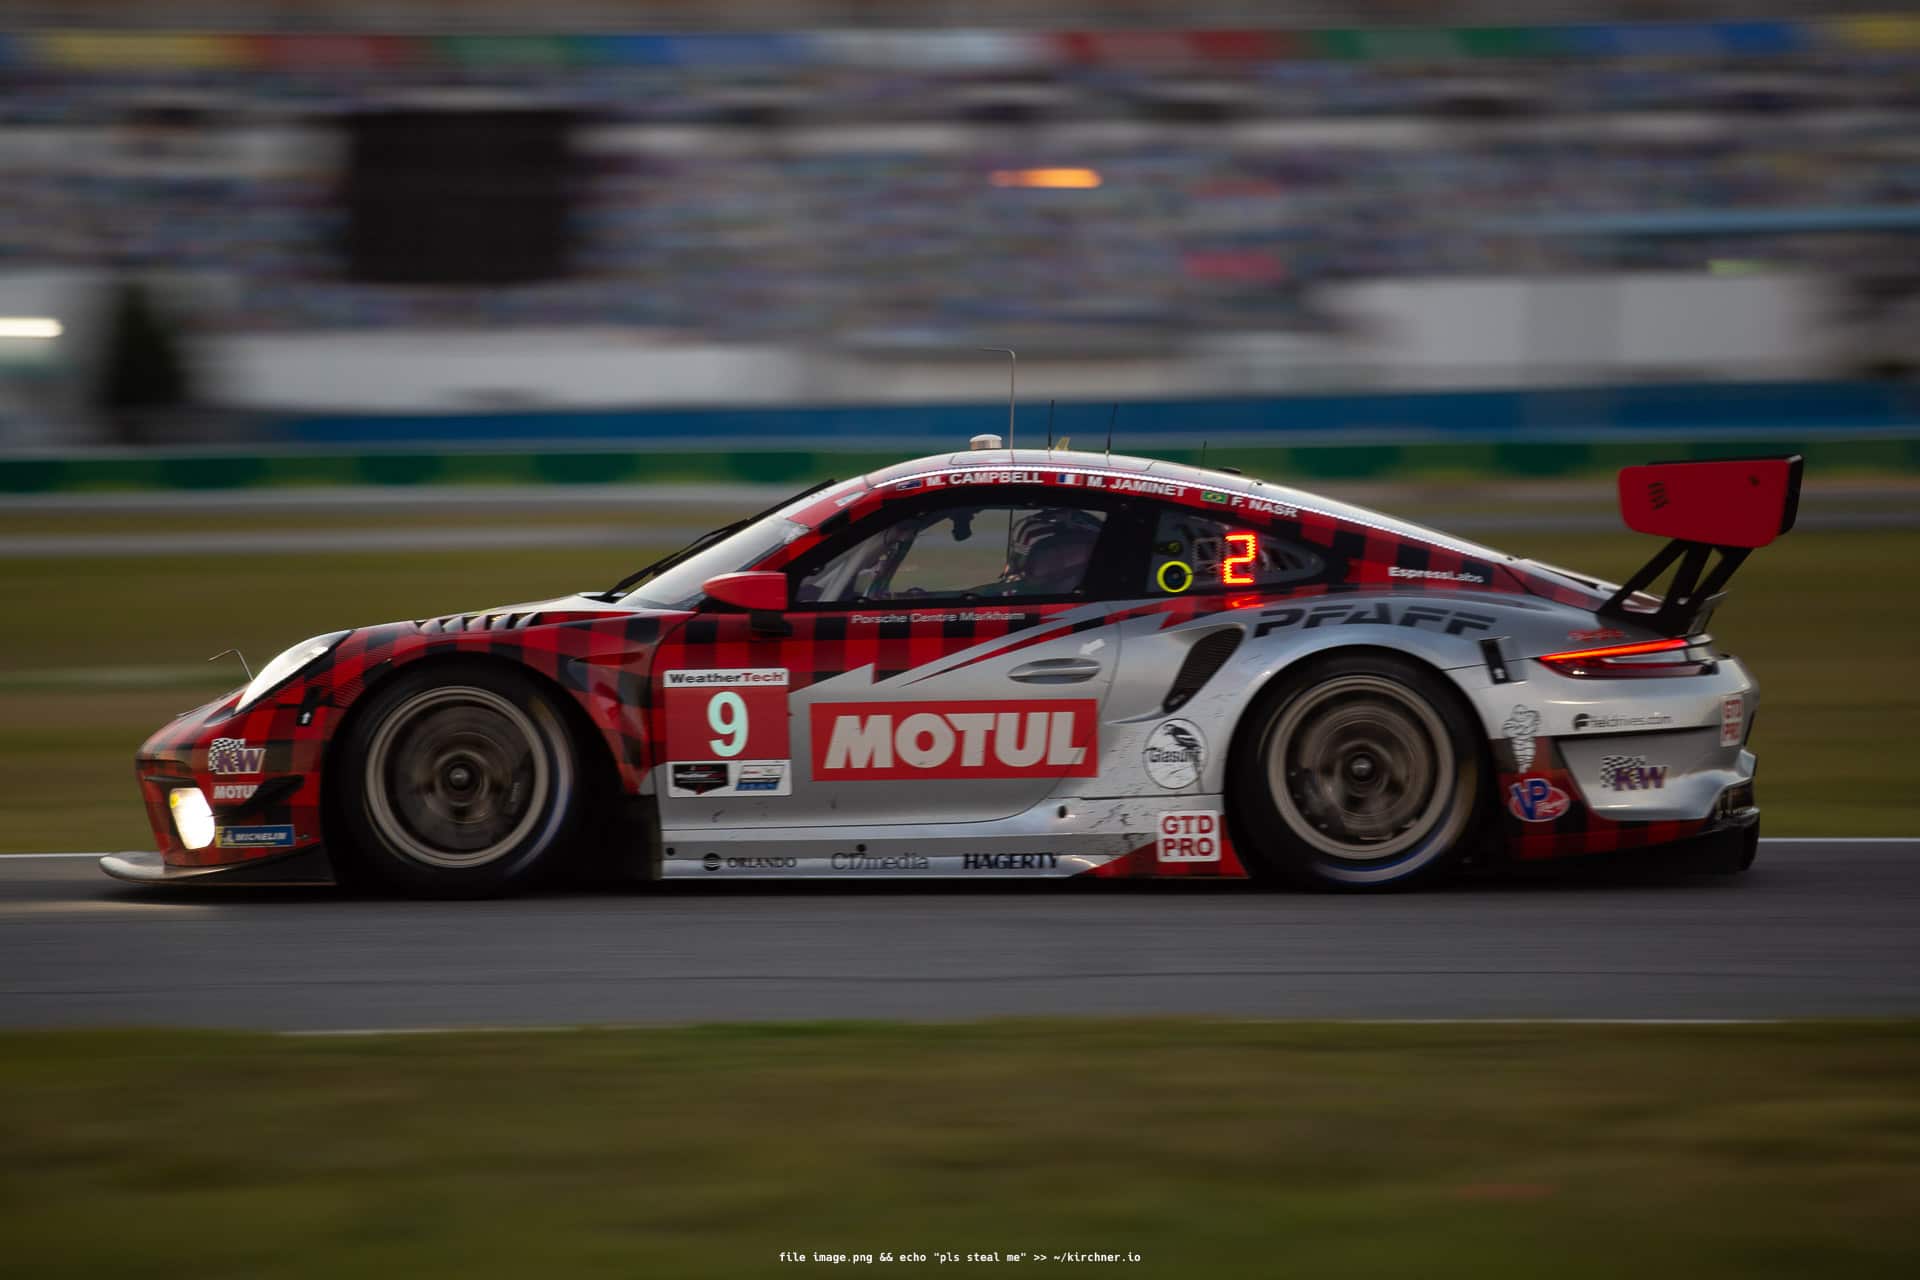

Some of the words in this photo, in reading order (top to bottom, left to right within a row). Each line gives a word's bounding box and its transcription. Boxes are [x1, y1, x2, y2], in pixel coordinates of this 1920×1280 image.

[926, 476, 946, 487] M.
[950, 471, 1044, 485] CAMPBELL
[1087, 475, 1106, 489] M.
[1109, 477, 1185, 497] JAMINET
[1231, 496, 1245, 507] F.
[1248, 499, 1298, 518] NASR
[1223, 533, 1256, 584] 2
[1388, 566, 1485, 583] EspressLabs
[851, 614, 907, 624] Porsche
[910, 612, 957, 622] Centre
[1253, 603, 1497, 638] PFAFF
[669, 672, 783, 683] WeatherTech
[707, 691, 749, 757] 9
[824, 711, 1088, 769] MOTUL
[217, 748, 265, 773] KW
[1614, 766, 1668, 791] KW
[1162, 815, 1214, 835] GTD
[1163, 838, 1214, 857] PRO
[727, 857, 797, 869] ORLANDO
[962, 852, 1058, 870] HAGERTY
